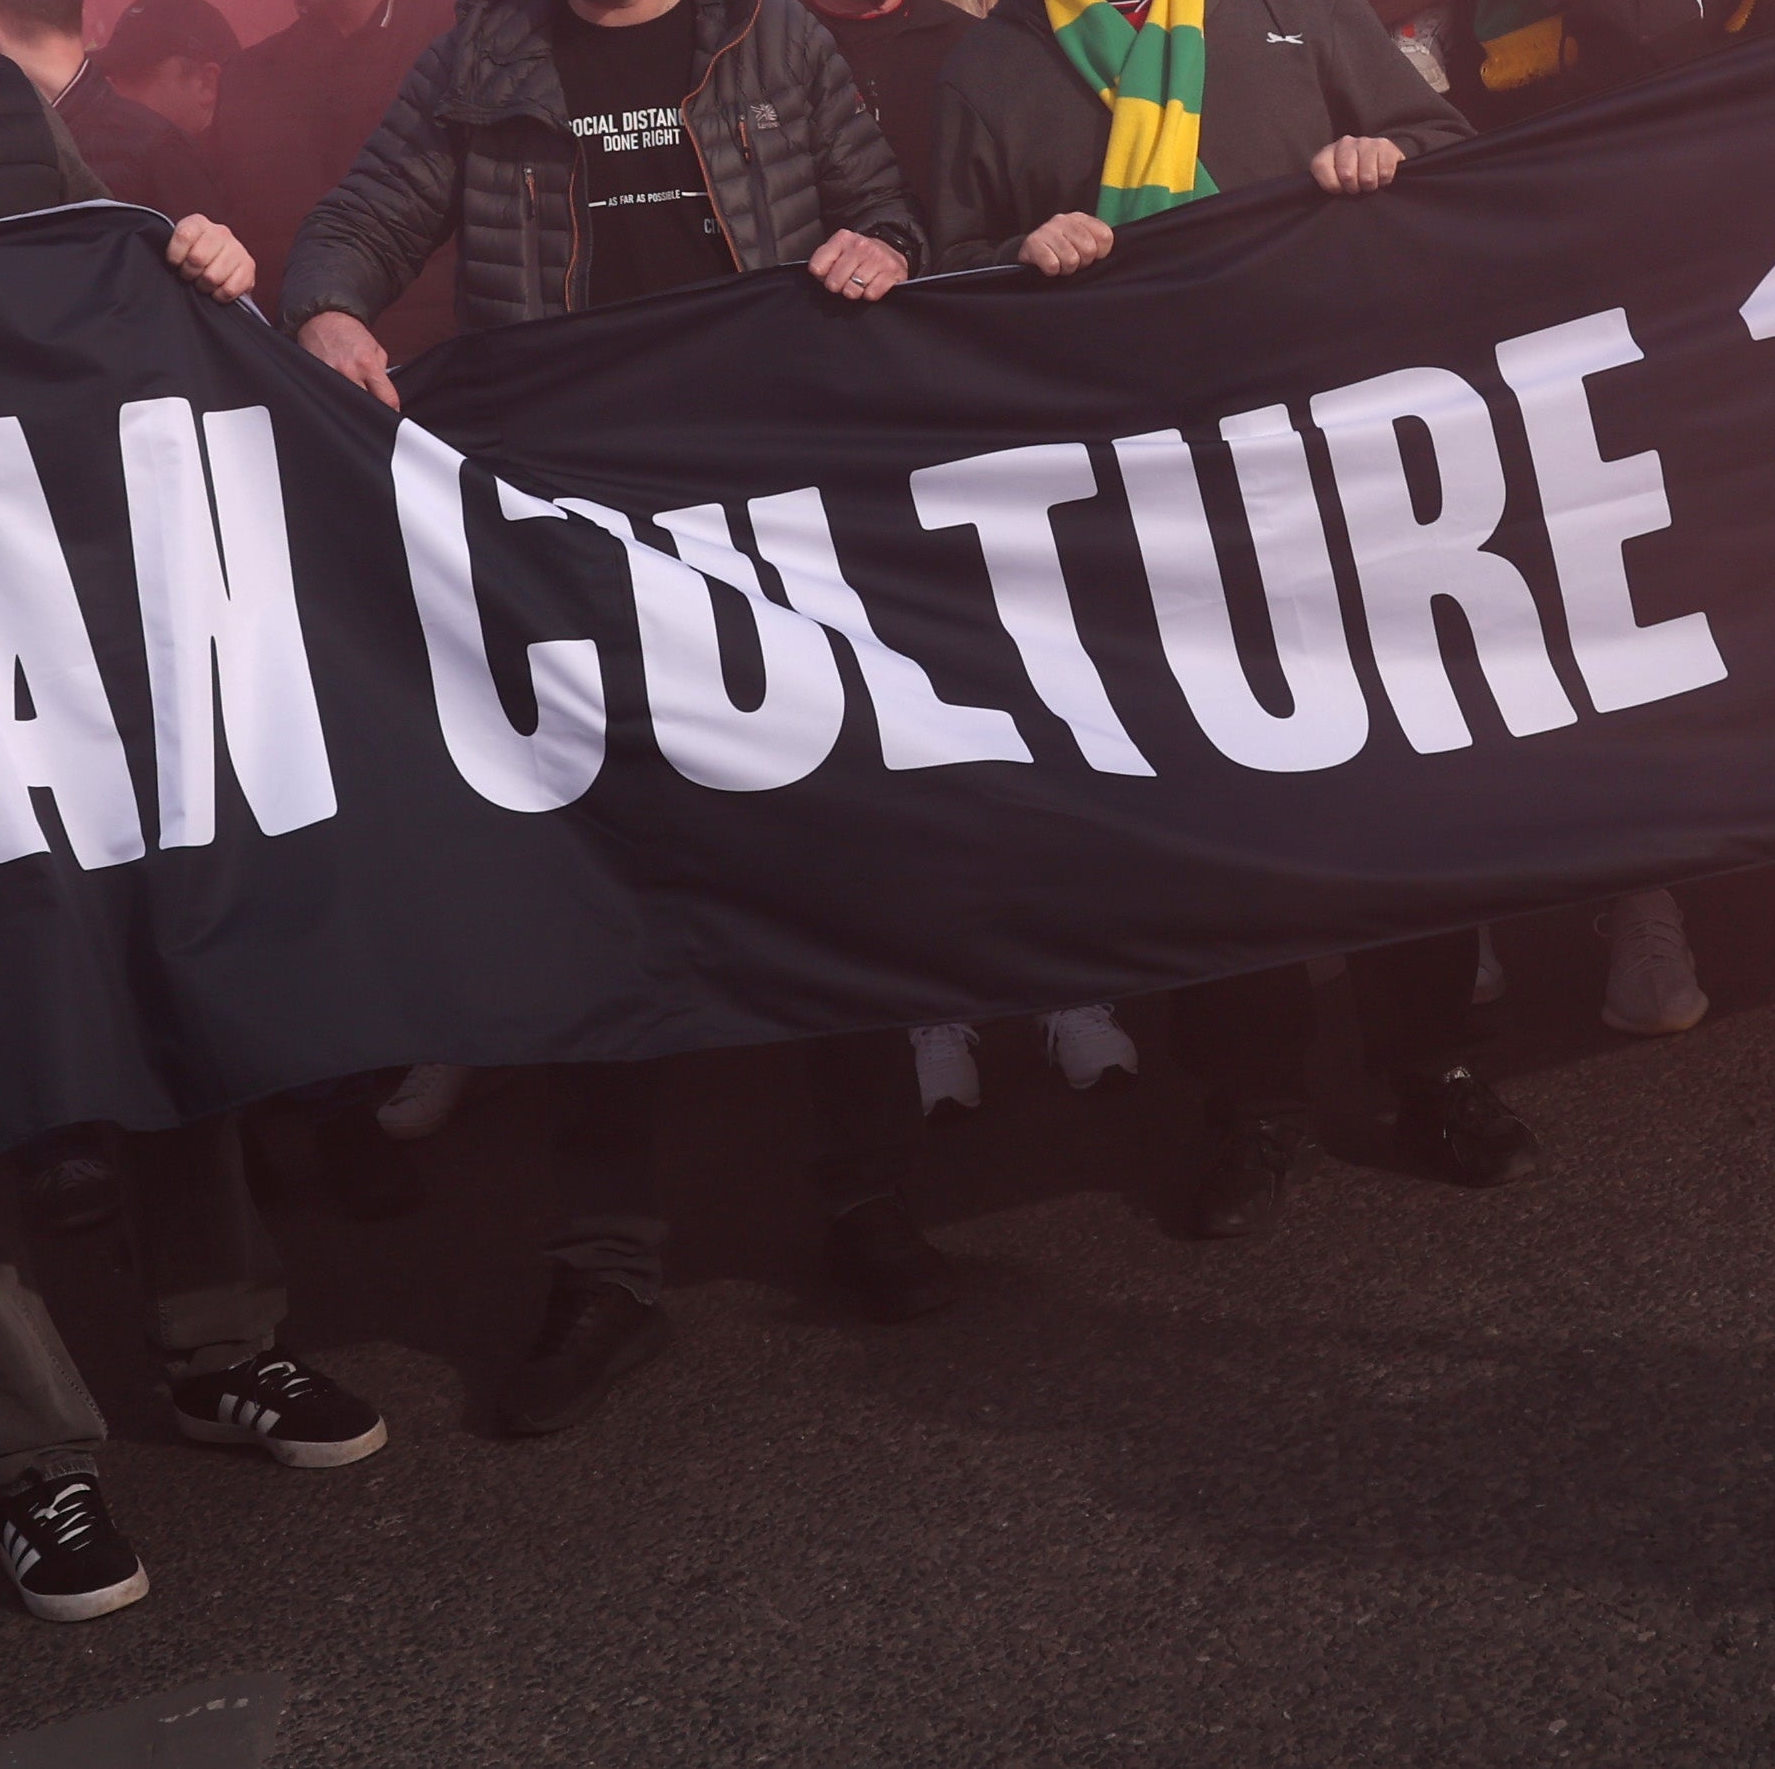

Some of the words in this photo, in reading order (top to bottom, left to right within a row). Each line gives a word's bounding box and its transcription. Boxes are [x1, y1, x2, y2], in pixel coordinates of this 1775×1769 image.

[568, 114, 619, 138] OCIAL
[603, 133, 639, 152] DONE
[642, 128, 681, 148] RIGHT
[608, 196, 618, 207] AS
[619, 193, 634, 205] FAR
[636, 193, 646, 204] AS
[647, 189, 681, 204] POSSIBLE
[390, 304, 1728, 815] CULTURE
